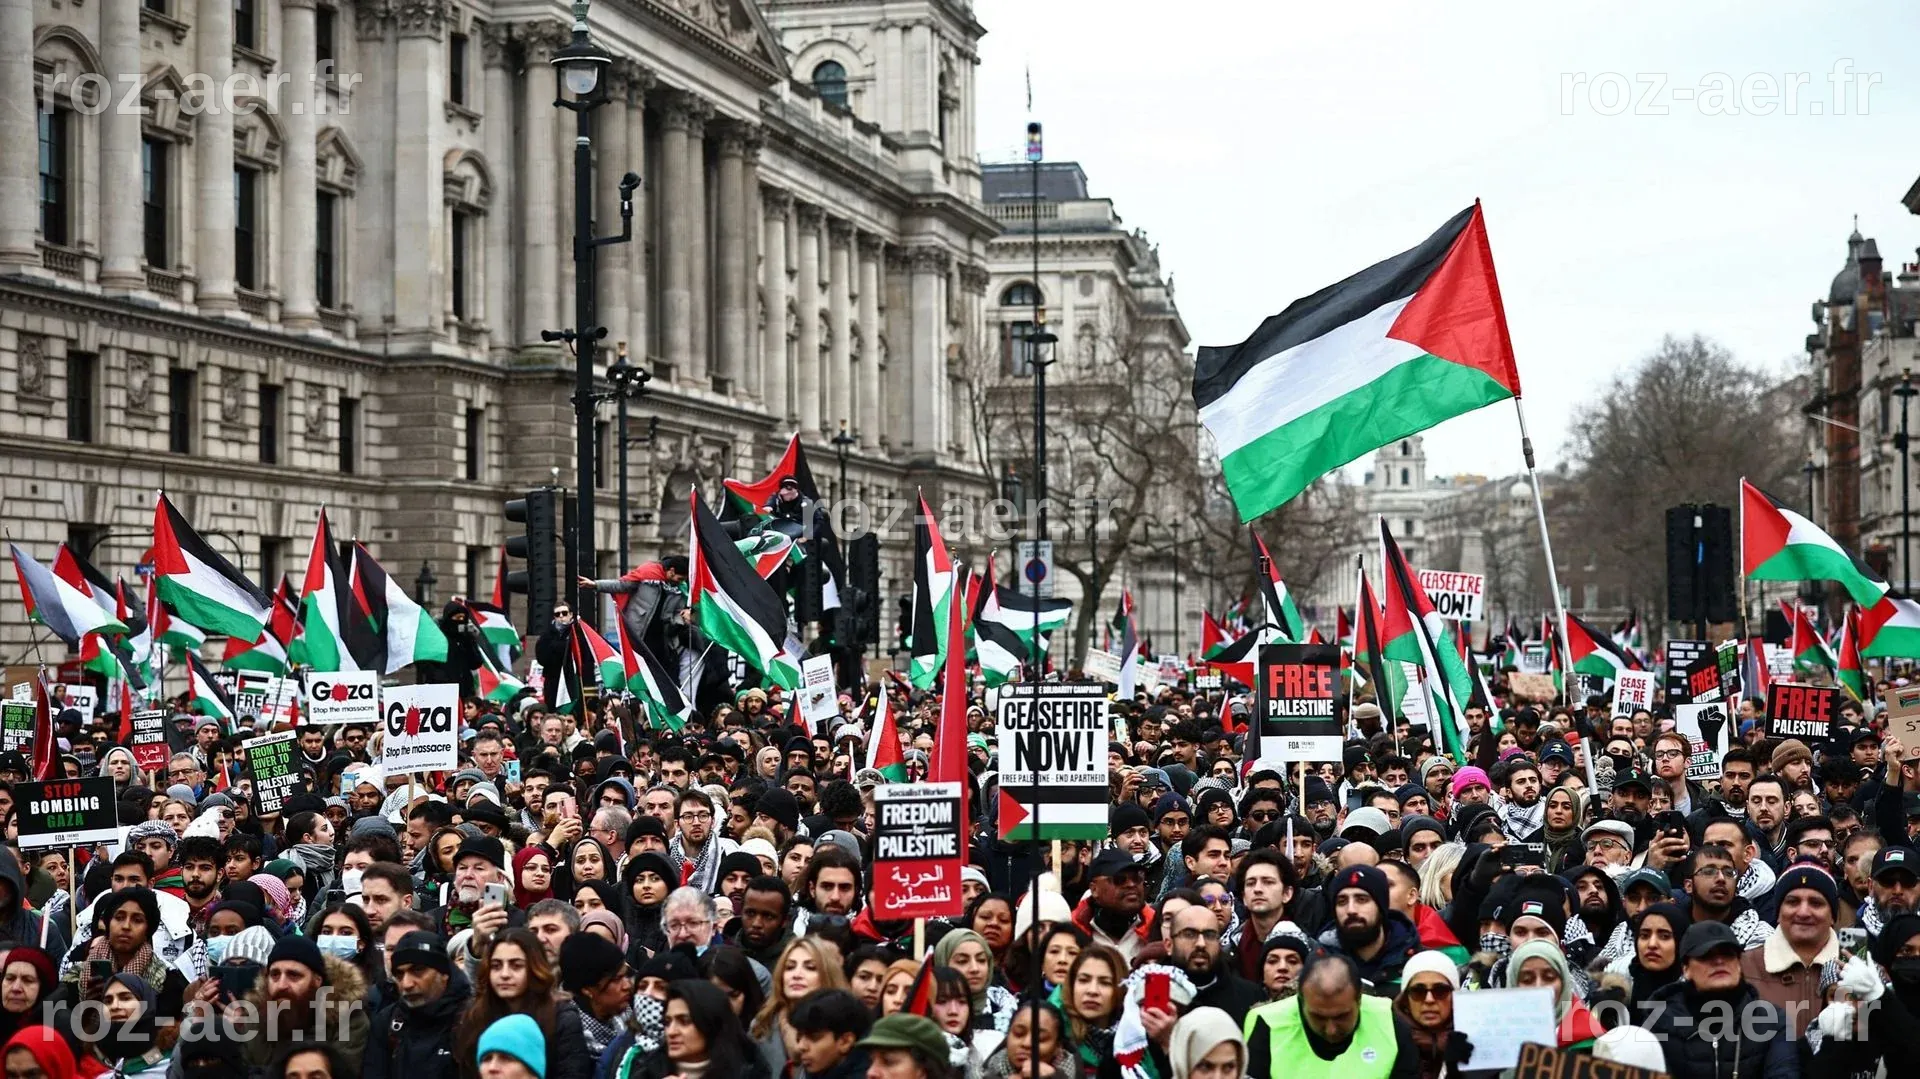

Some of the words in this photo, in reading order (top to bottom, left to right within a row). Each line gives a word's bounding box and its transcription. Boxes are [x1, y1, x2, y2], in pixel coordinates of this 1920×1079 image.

[1420, 572, 1483, 594] CEASEFIRE
[1269, 664, 1333, 698] FREE
[1620, 677, 1647, 690] CEASE
[1690, 665, 1719, 697] FREE
[1015, 686, 1043, 695] PALESTE
[1619, 689, 1645, 702] FRE
[1269, 699, 1334, 716] PALESTINE
[1774, 687, 1832, 722] FREE
[1004, 701, 1104, 730] CEASEFIRE
[4, 729, 34, 738] PALESTINE
[1772, 719, 1829, 737] PALESTINE
[1906, 720, 1920, 732] S
[250, 744, 274, 759] FROM
[274, 741, 292, 754] THE
[386, 746, 400, 758] Stop
[401, 745, 411, 755] the
[411, 743, 451, 753] massacre
[1691, 742, 1710, 752] IST.
[252, 755, 278, 770] RIVER
[277, 753, 290, 764] TO
[1691, 753, 1713, 764] SIST.
[254, 767, 272, 780] THE
[272, 764, 289, 777] SEA
[1002, 774, 1019, 783] FREE
[1019, 774, 1050, 783] PALEINE
[1055, 774, 1069, 783] END
[1070, 774, 1106, 783] APARTHEID
[257, 772, 300, 791] PALESTINE
[43, 783, 82, 799] STOP
[258, 789, 281, 802] WILL
[281, 785, 293, 797] BE
[887, 788, 920, 797] Socialist
[922, 788, 948, 796] Worker
[30, 796, 100, 815] BOMBING
[261, 798, 283, 813] FREE
[882, 802, 952, 825] FREEDOM
[46, 812, 84, 828] GAZA
[54, 834, 65, 842] FOA
[913, 824, 926, 835] for
[878, 834, 957, 858] PALESTINE
[891, 864, 944, 887] الحرية
[885, 885, 952, 909] لفلسطين
[1517, 1043, 1672, 1079] PALES
